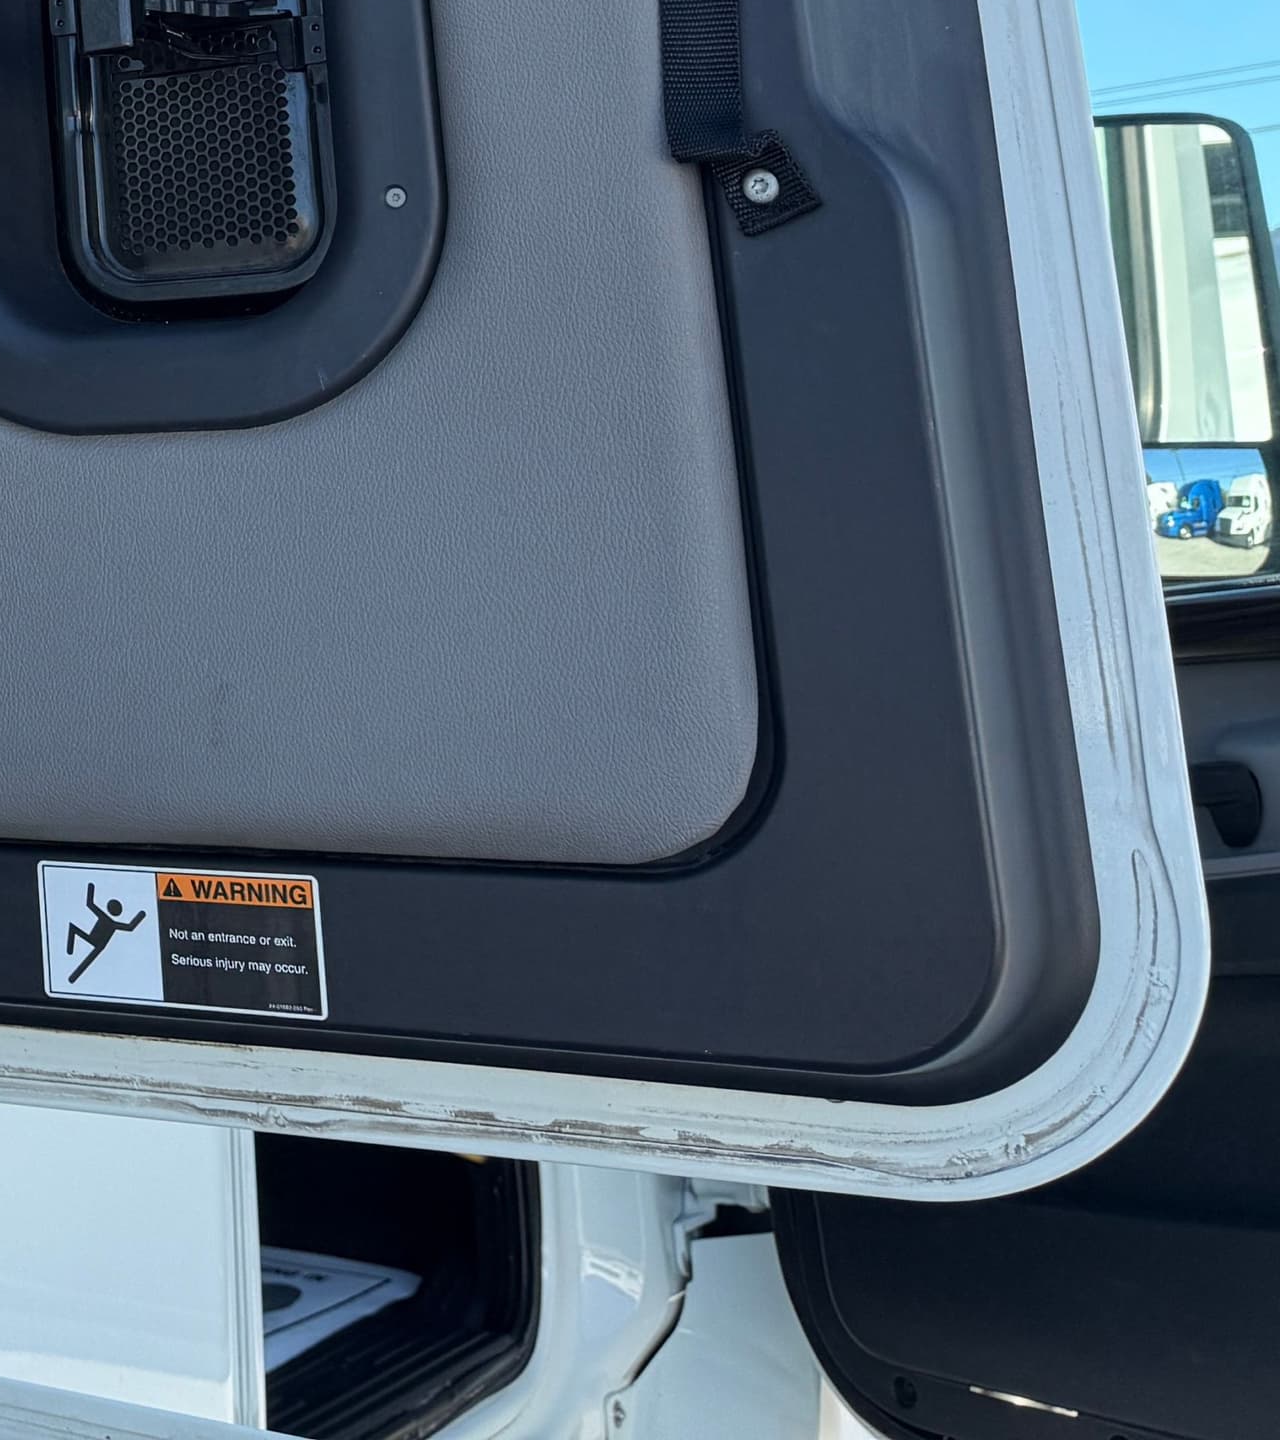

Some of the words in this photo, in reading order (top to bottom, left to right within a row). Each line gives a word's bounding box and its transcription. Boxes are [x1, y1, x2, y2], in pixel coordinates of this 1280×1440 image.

[191, 879, 307, 905] WARNING
[169, 928, 188, 940] Not
[191, 932, 205, 941] an
[208, 932, 256, 944] entrance
[260, 936, 271, 945] or
[274, 936, 297, 947] exit.
[171, 953, 213, 967] Serious
[215, 957, 245, 972] injury
[248, 961, 271, 974] may
[274, 963, 309, 975] occur.
